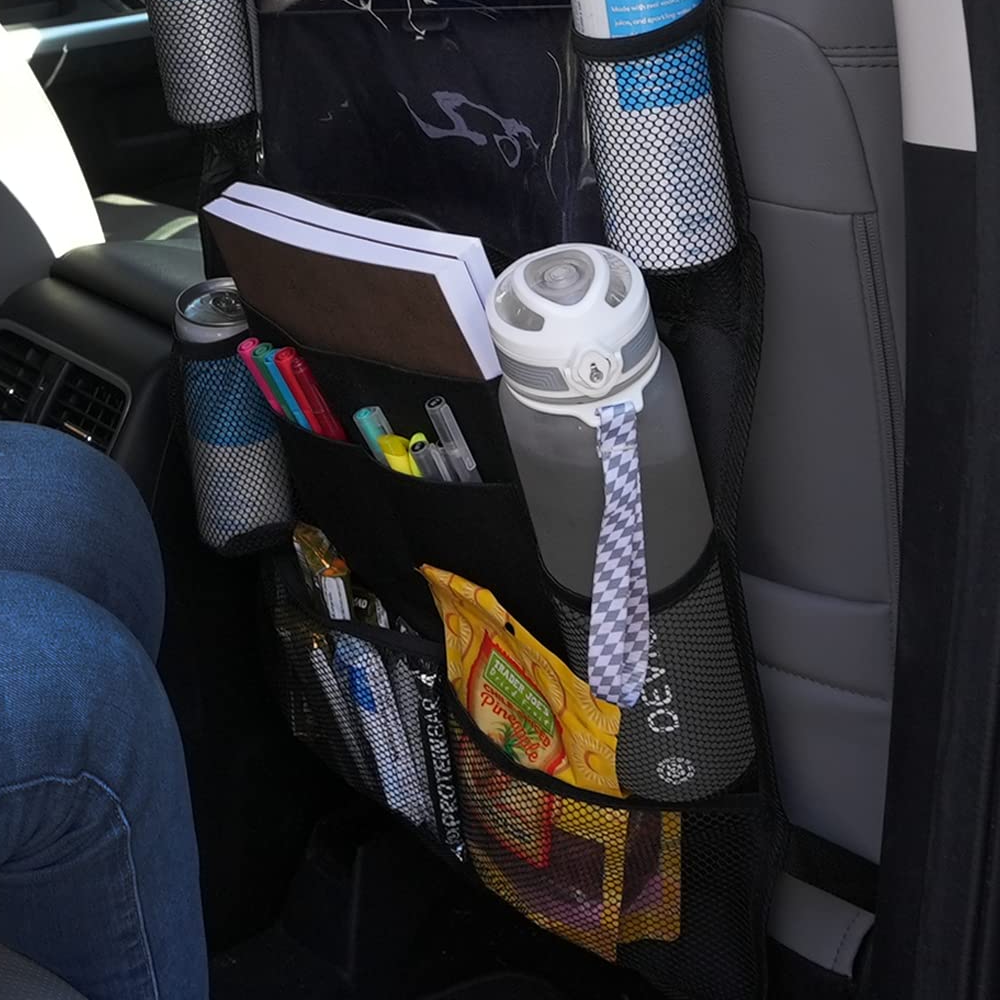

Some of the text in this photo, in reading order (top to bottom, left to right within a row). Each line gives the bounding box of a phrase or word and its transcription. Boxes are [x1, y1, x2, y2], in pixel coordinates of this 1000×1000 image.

[489, 667, 518, 697] Dried
[494, 660, 550, 717] TRADER JOE'S
[480, 691, 540, 763] Pineapple
